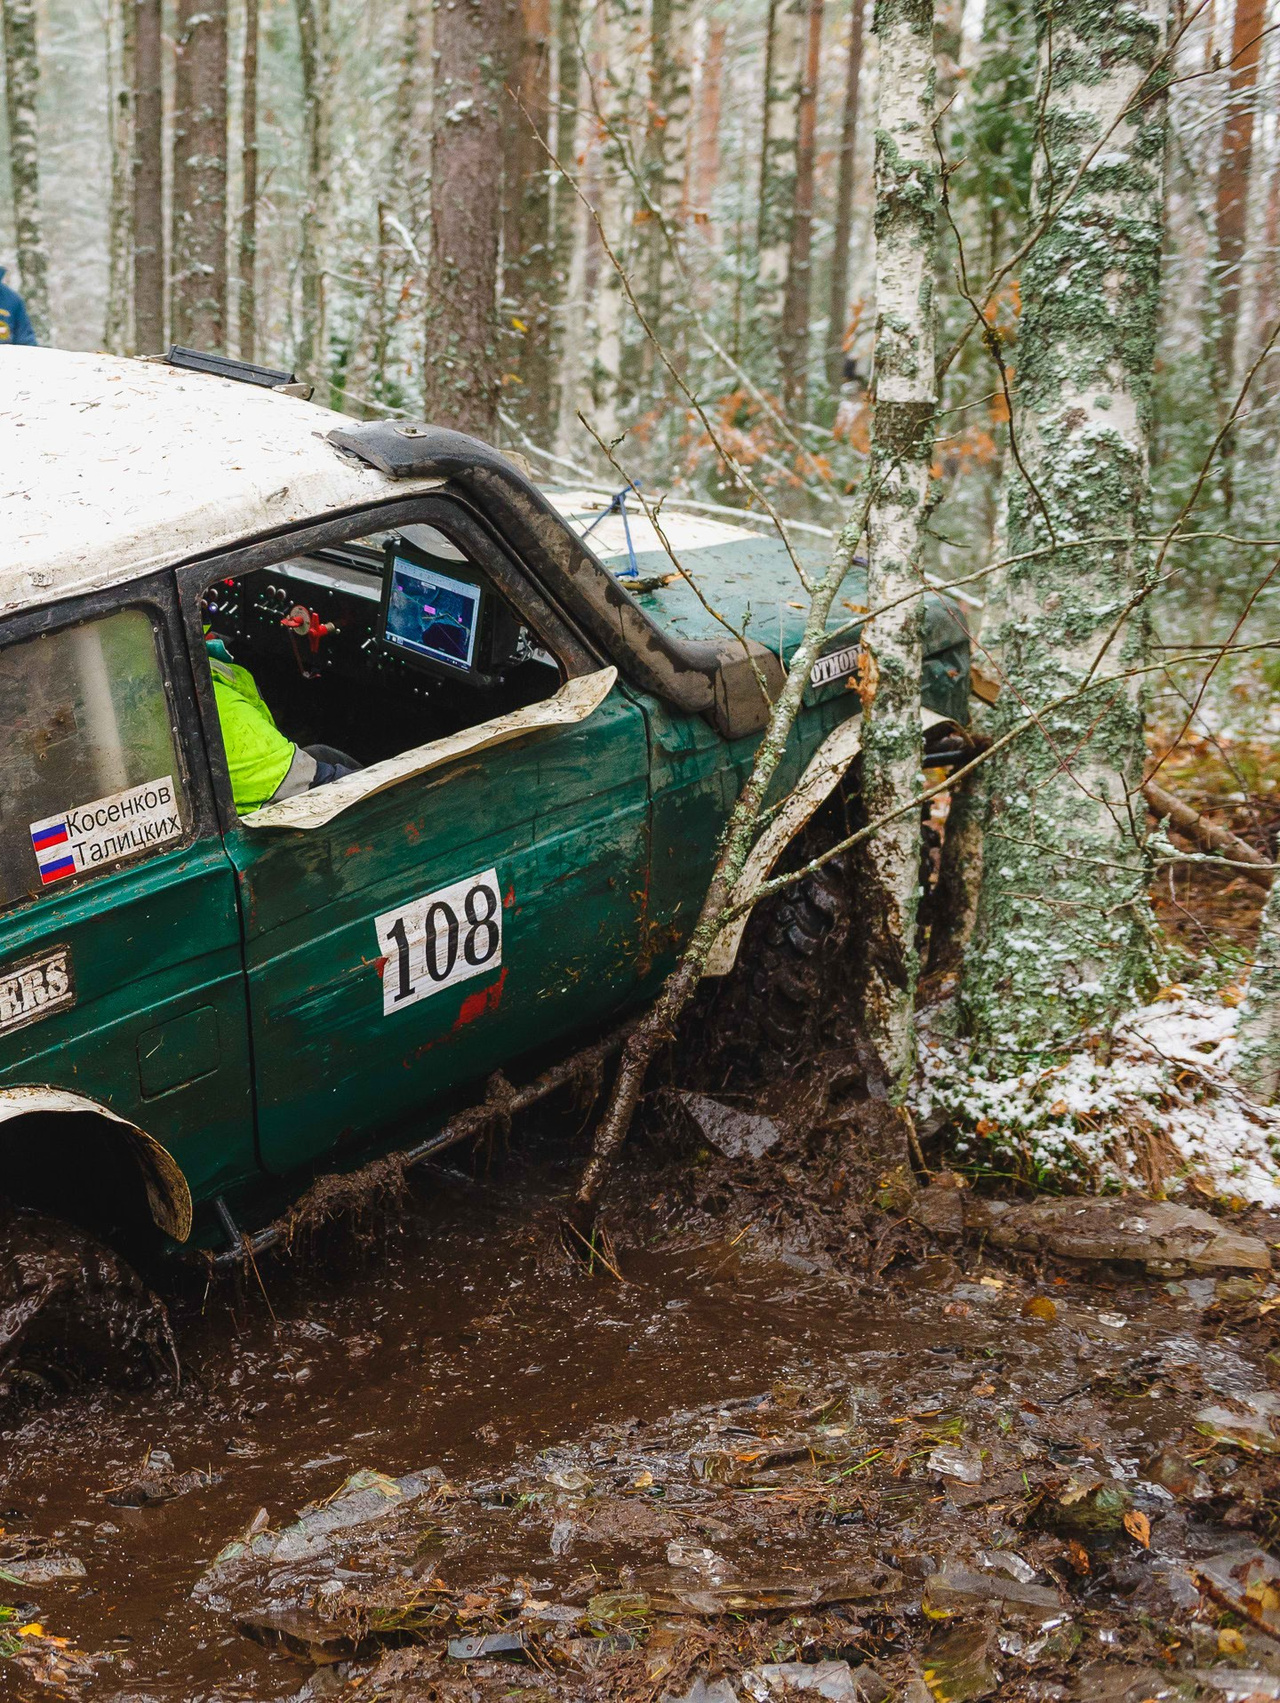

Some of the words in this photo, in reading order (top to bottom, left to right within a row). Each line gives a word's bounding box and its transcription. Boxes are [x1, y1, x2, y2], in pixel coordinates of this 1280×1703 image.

[811, 648, 862, 682] OTMOR
[66, 787, 170, 837] Косенков
[72, 814, 180, 865] Талицких
[387, 884, 499, 1002] 108
